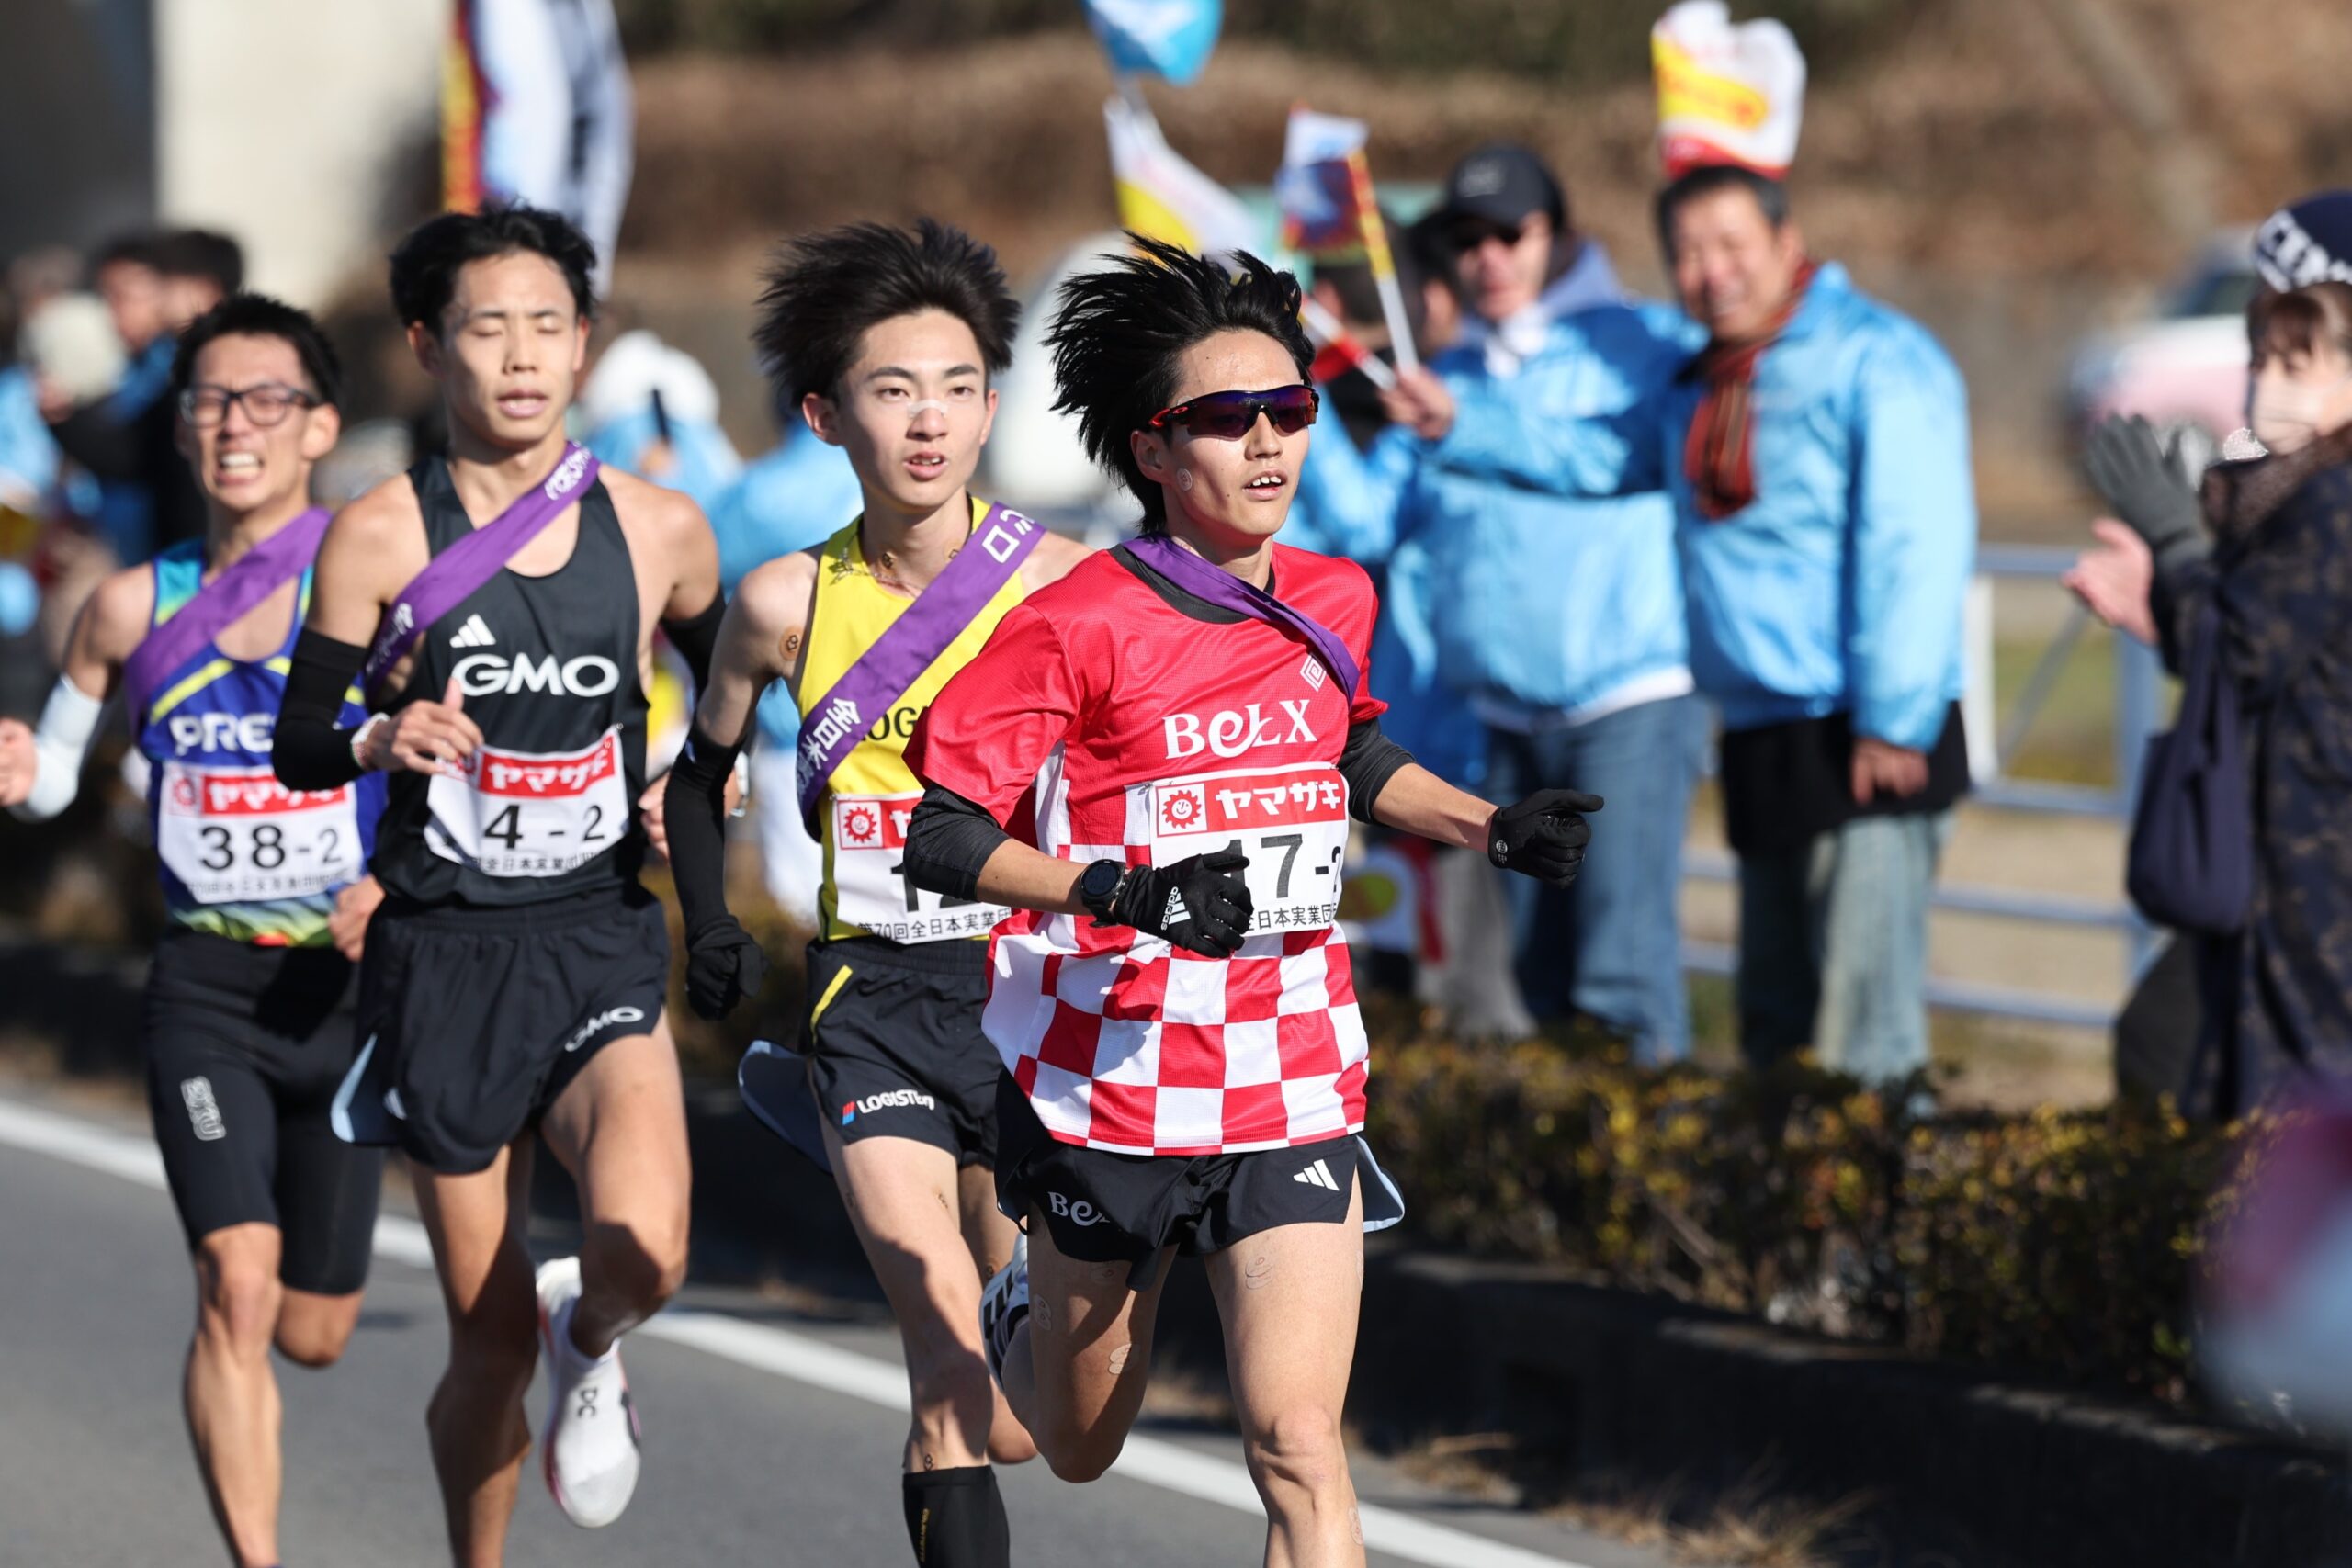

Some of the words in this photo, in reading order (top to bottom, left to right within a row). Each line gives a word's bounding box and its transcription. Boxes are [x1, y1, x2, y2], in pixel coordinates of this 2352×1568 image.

[451, 651, 620, 698] GMO
[169, 712, 275, 756] PRE
[862, 706, 926, 742] OG
[1215, 781, 1341, 820] ヤマザキ
[200, 824, 342, 871] 38-2
[483, 804, 605, 850] 4-2
[1160, 886, 1179, 931] adidas
[1248, 902, 1337, 931] 日本実業団
[564, 1006, 645, 1052] GMO
